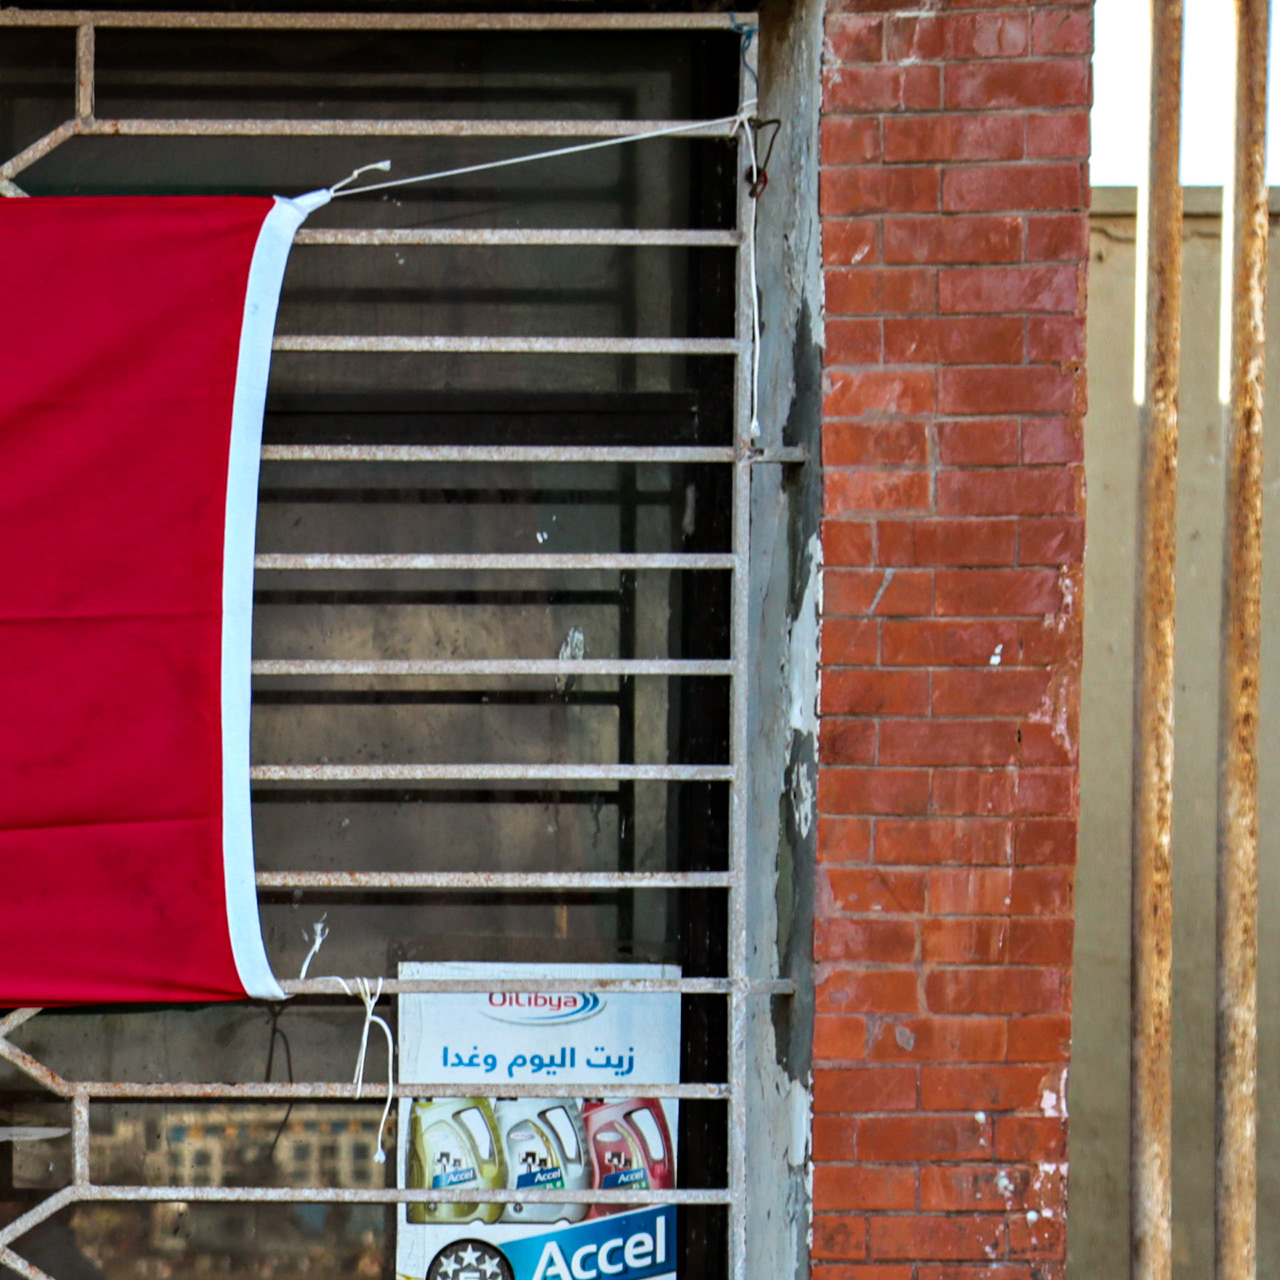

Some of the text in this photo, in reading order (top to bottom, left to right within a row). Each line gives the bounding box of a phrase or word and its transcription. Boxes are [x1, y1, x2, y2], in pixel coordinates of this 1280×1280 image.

[488, 992, 577, 1011] OiLibya
[443, 1046, 634, 1078] زيت اليوم وغدا
[447, 1171, 474, 1184] Accel
[535, 1170, 561, 1183] Accel
[618, 1170, 643, 1184] Accel
